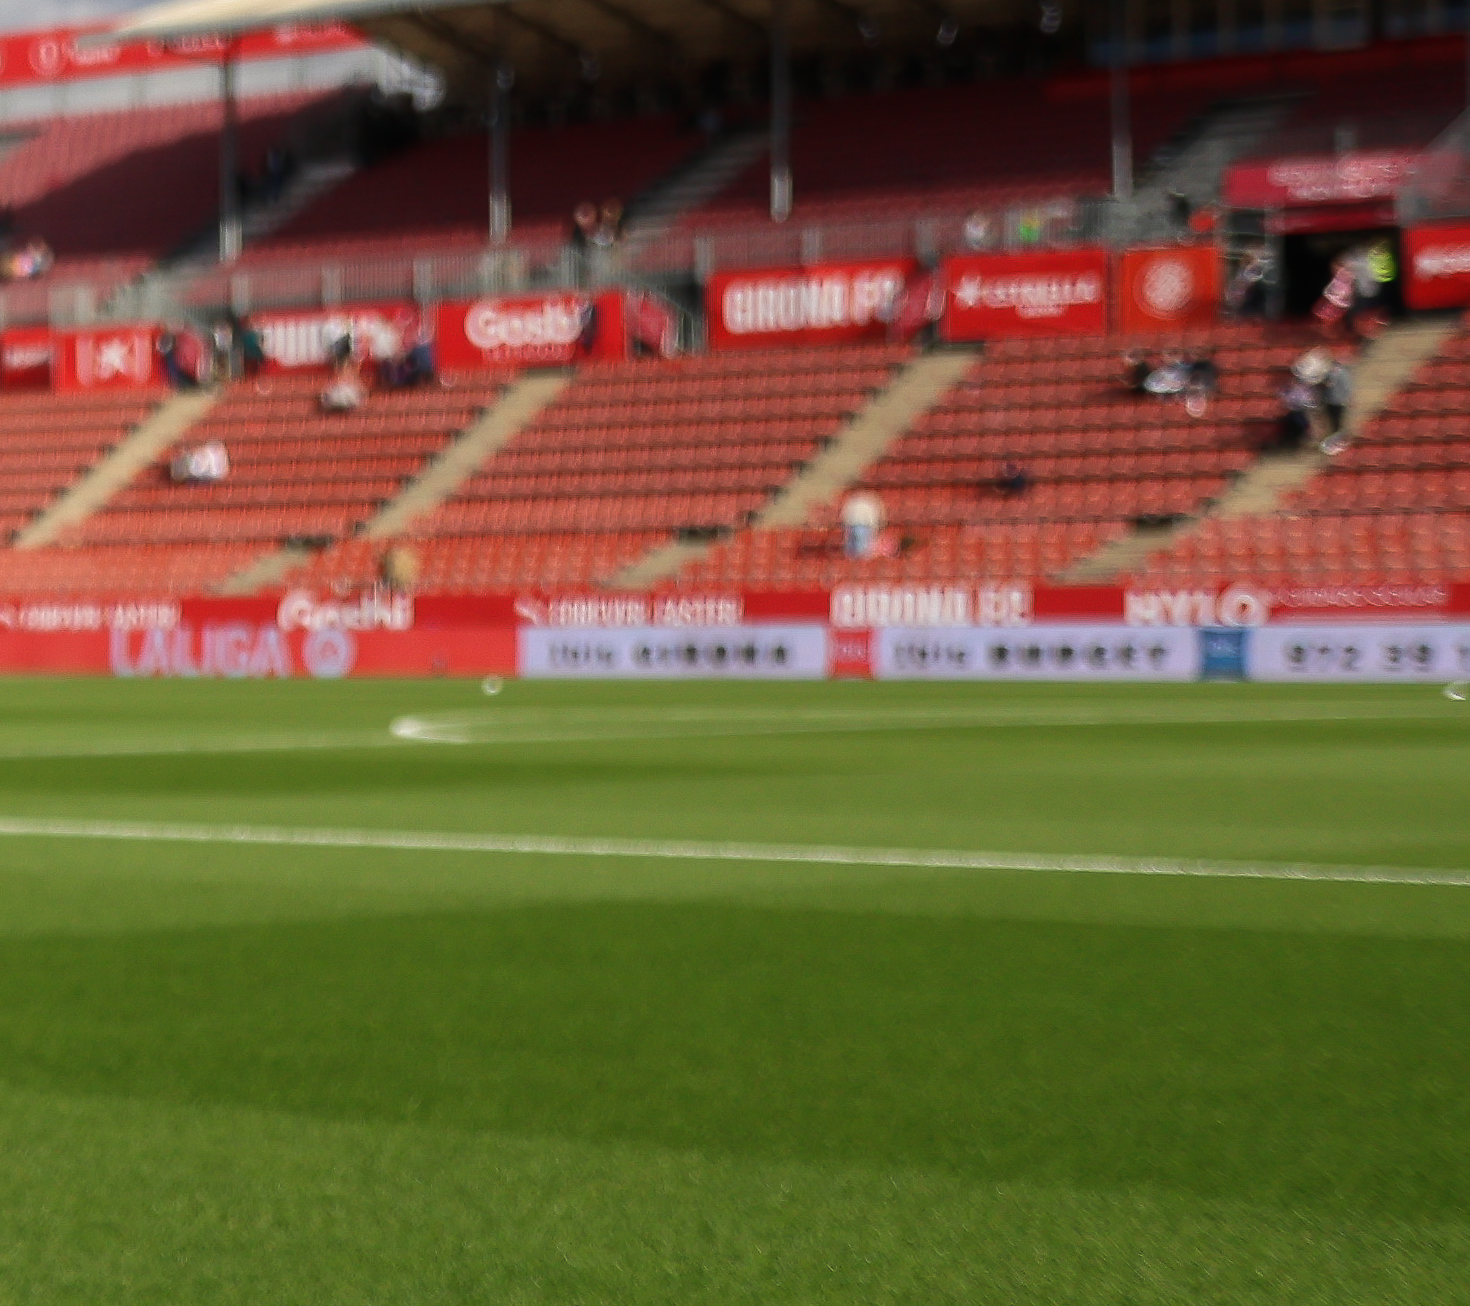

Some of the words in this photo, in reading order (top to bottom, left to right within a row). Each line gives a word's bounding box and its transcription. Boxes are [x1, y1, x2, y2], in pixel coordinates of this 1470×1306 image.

[463, 295, 593, 349] Gosb
[723, 271, 850, 334] GIRONA
[829, 584, 974, 627] GIRONA
[108, 622, 293, 679] LALIGA
